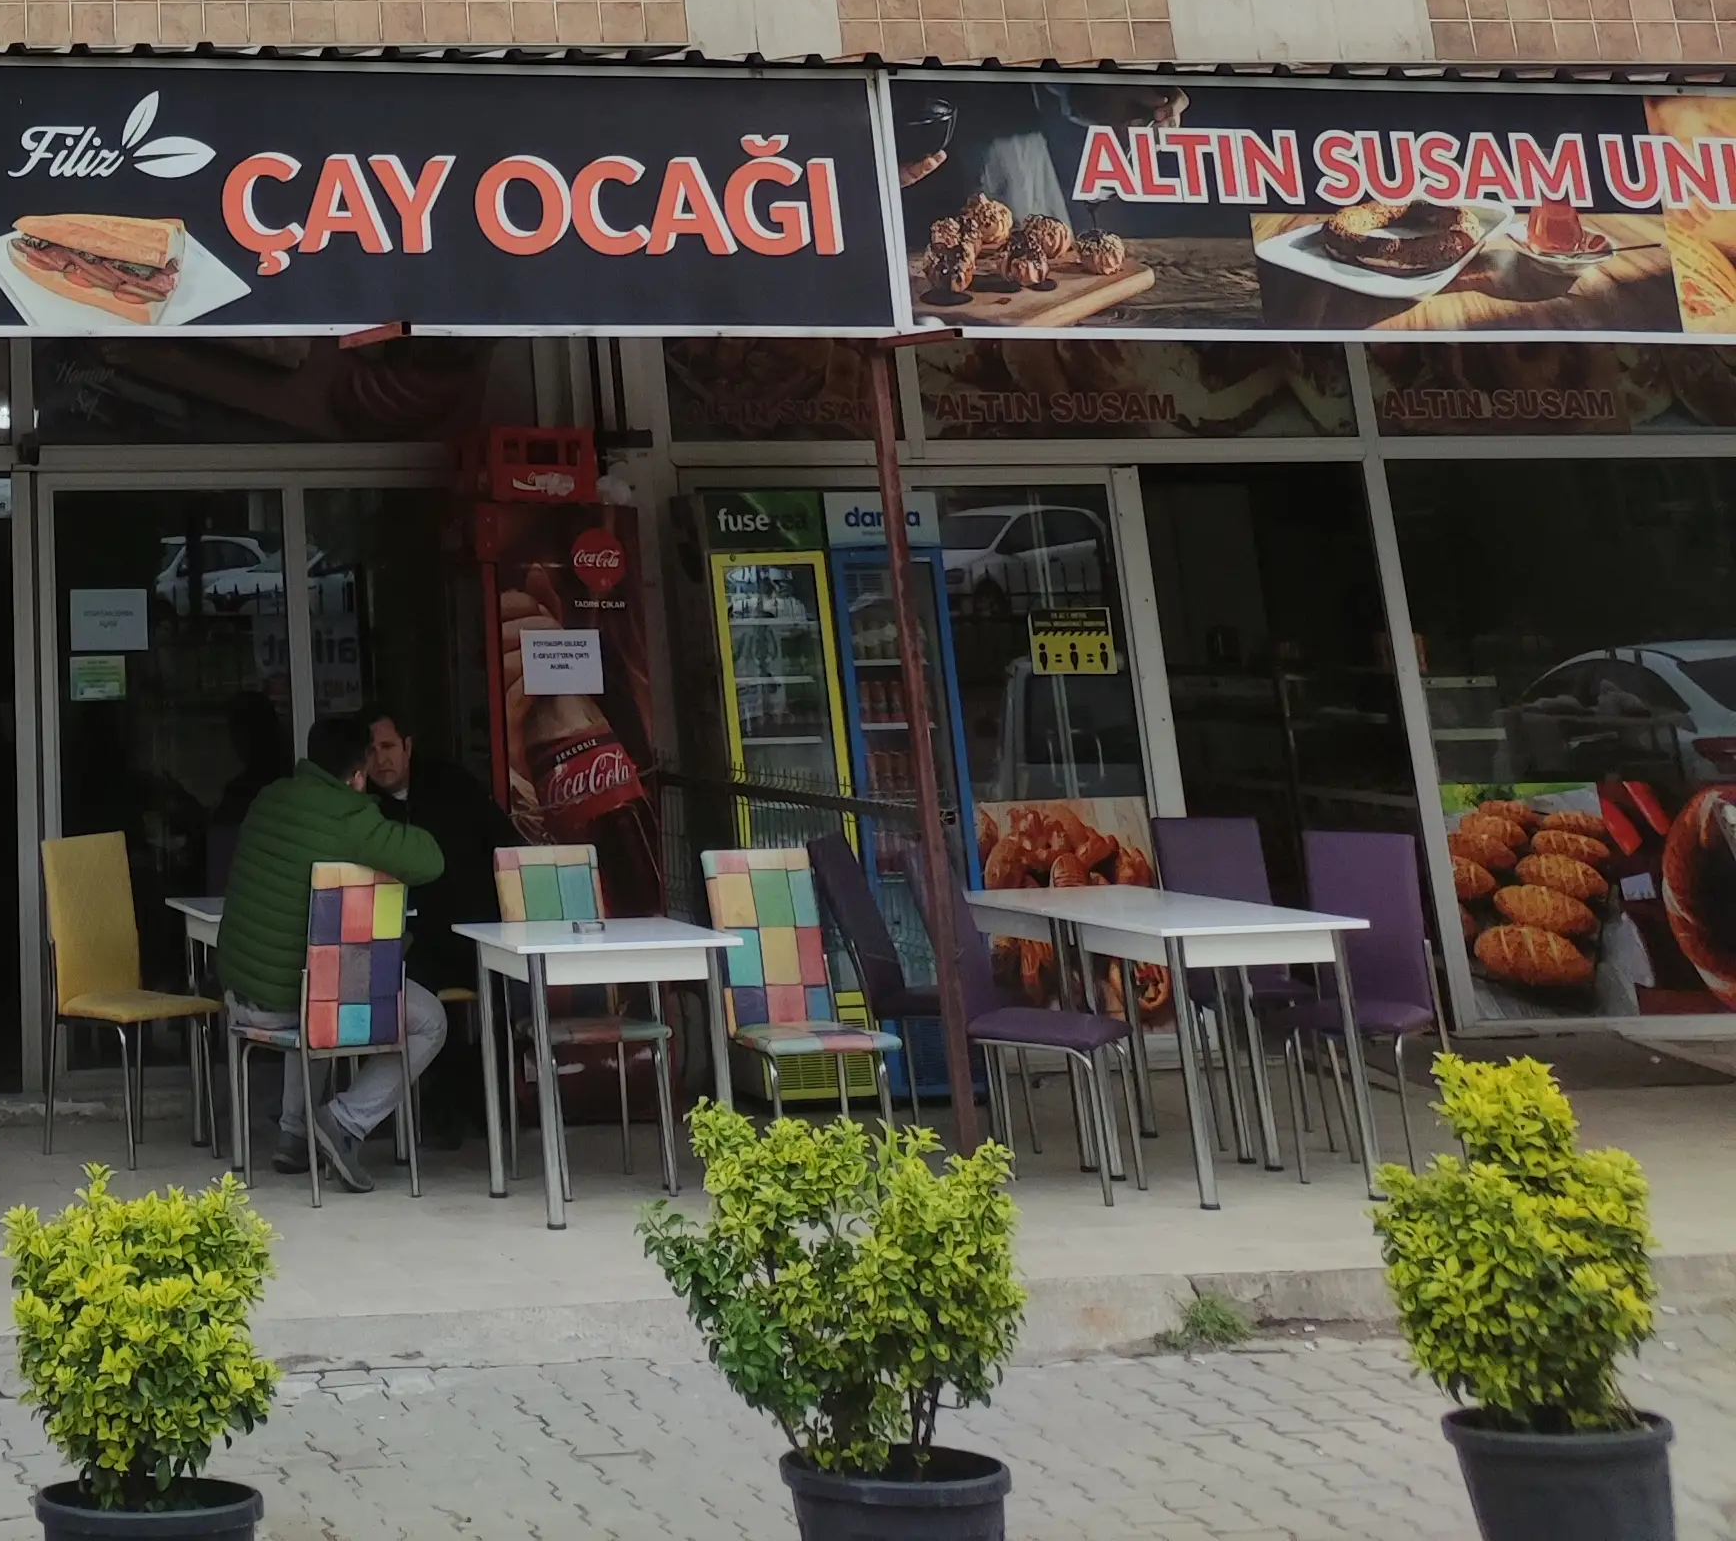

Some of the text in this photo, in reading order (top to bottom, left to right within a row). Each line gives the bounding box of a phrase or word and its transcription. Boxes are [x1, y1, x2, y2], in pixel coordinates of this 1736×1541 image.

[7, 124, 124, 181] Filiz
[1072, 124, 1307, 205] ALTIN
[1313, 129, 1595, 208] SUSAM
[220, 133, 845, 277] ÇAY OCAĞI
[935, 391, 1178, 423] ALTIN SUSAM
[1383, 387, 1616, 419] ALTIN SUSAM
[717, 507, 770, 532] fuse
